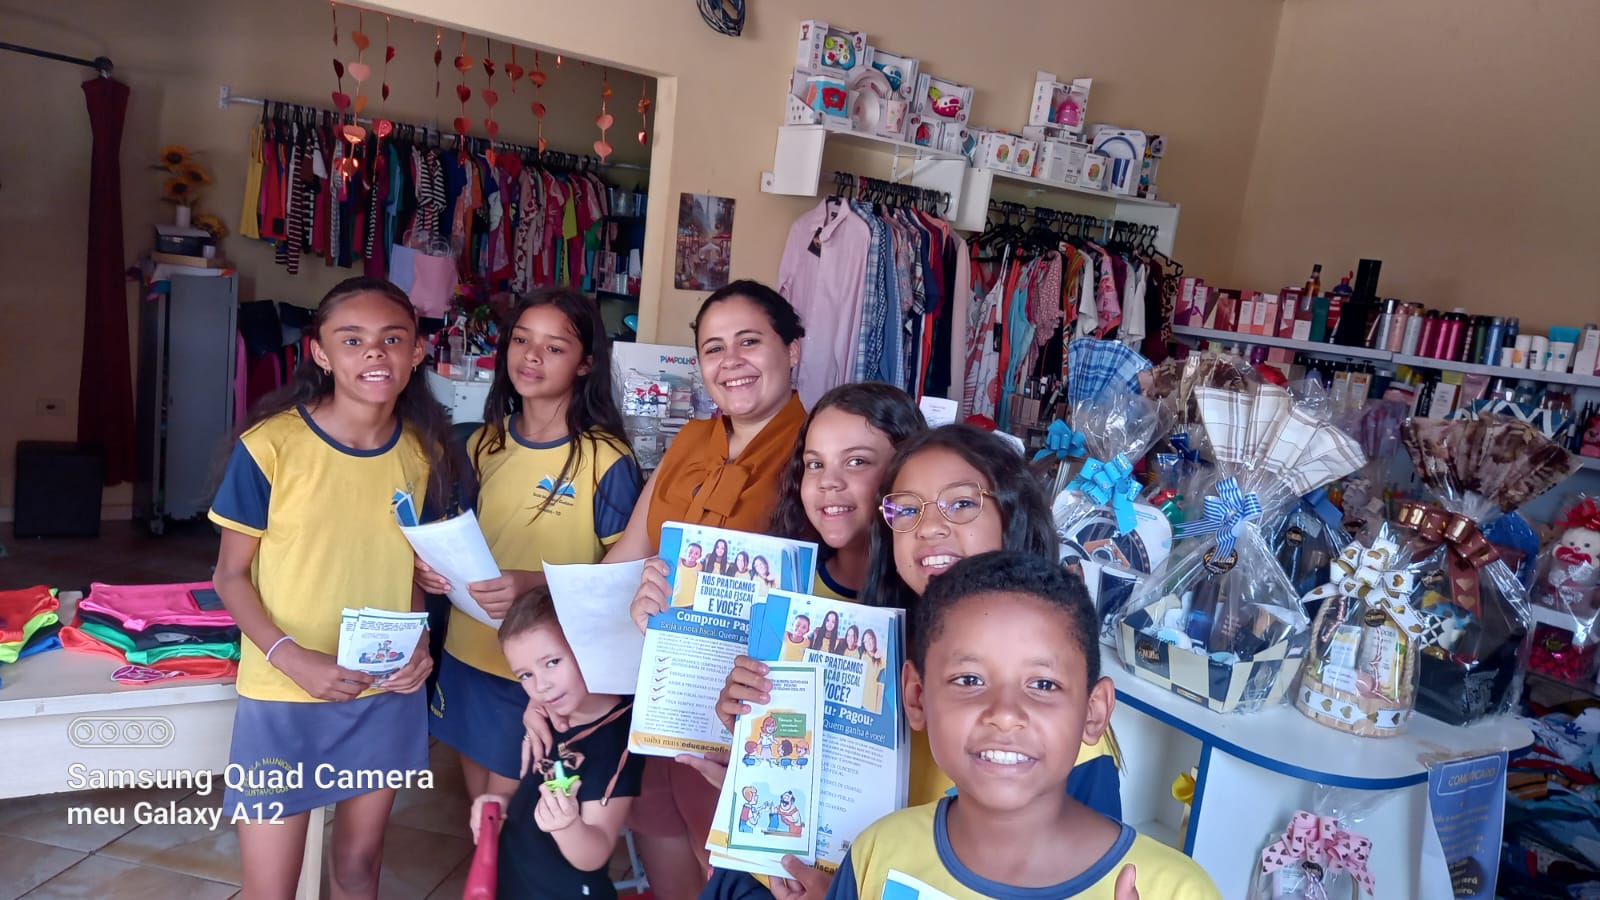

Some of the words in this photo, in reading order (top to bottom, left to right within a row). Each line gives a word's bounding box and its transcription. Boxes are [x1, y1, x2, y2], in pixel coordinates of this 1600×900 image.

[716, 577, 756, 593] PRATICAMOS
[708, 598, 714, 612] E
[718, 631, 739, 640] Quem
[841, 672, 861, 687] FISCAL
[823, 718, 845, 731] Quem
